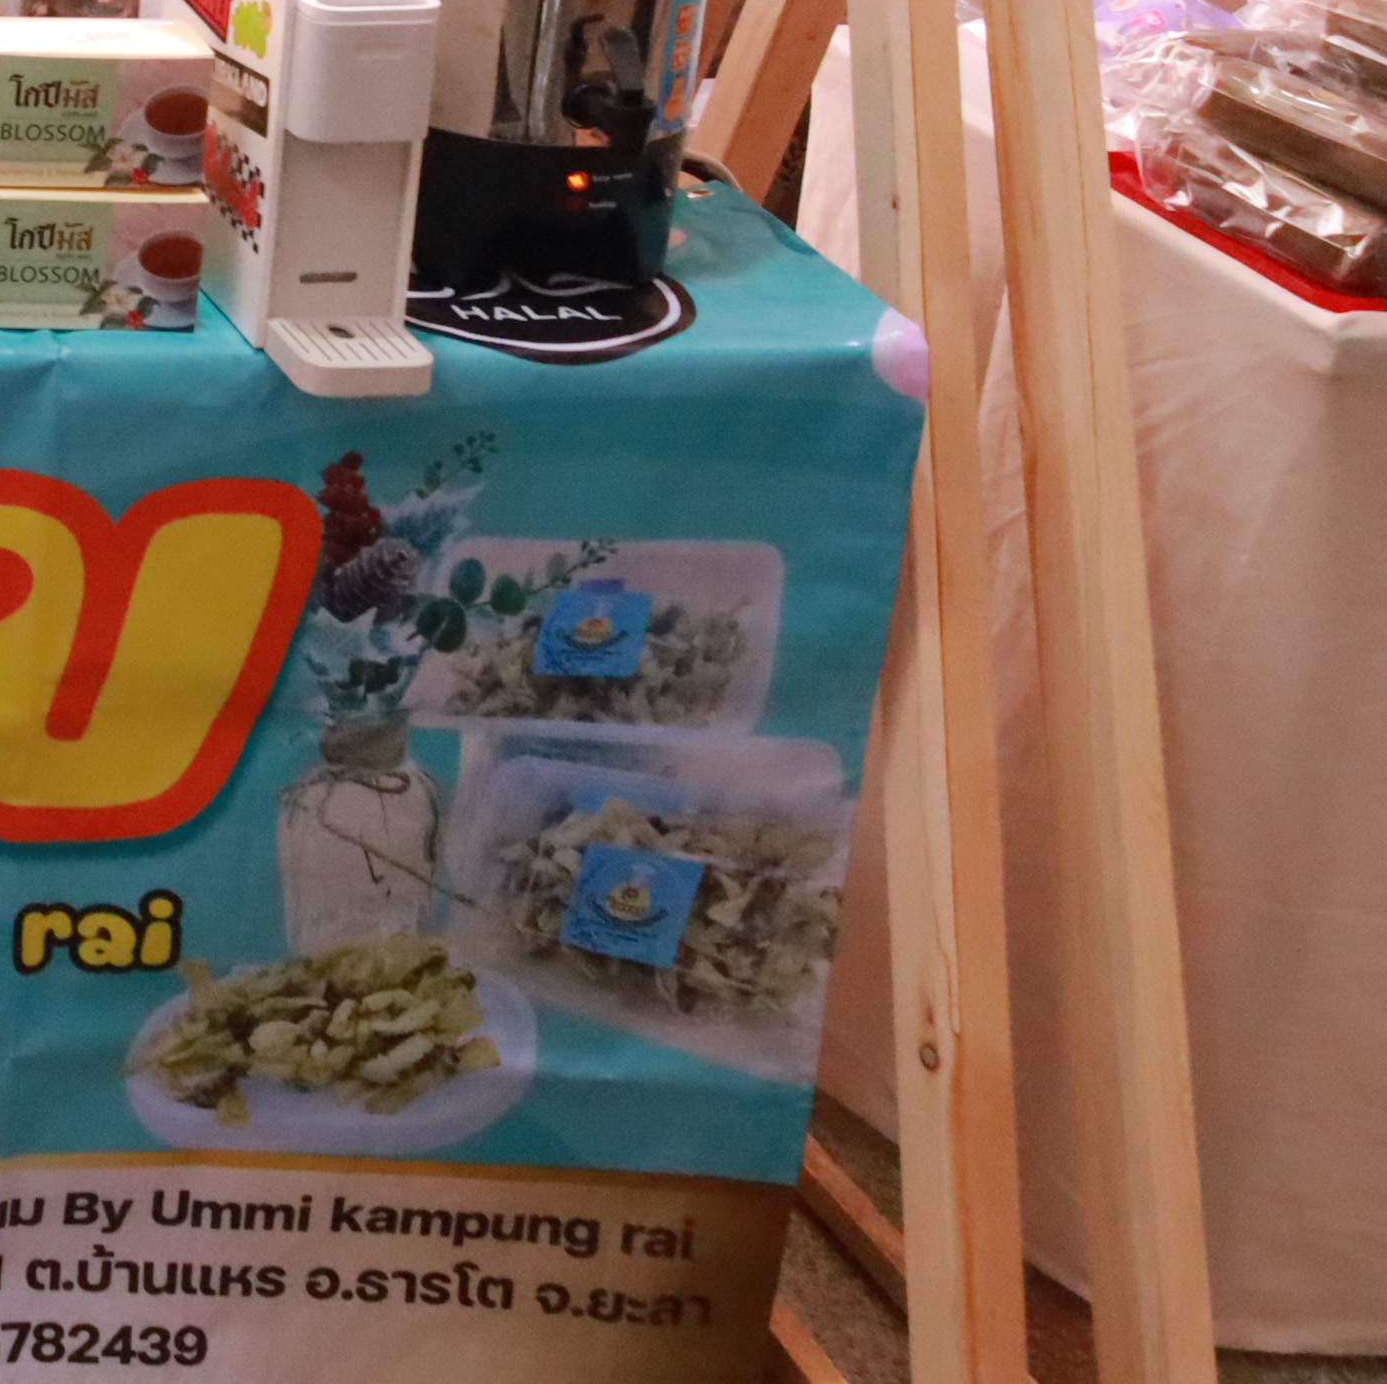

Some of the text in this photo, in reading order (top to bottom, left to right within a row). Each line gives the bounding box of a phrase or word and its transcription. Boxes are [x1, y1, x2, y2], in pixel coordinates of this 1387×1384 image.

[9, 74, 100, 109] โกปีมัส
[0, 123, 105, 143] BLOSSOM
[4, 217, 94, 252] โกปีมัส
[450, 304, 623, 321] HALAL
[14, 890, 182, 974] rai
[62, 1192, 133, 1234] By
[151, 1189, 312, 1232] Ummi
[330, 1196, 600, 1258] kampung
[621, 1217, 695, 1259] rai
[26, 1244, 285, 1297] ต.บ้านแหร
[305, 1262, 514, 1310] อ.ธารโต
[536, 1281, 713, 1327] จ.ยะลา
